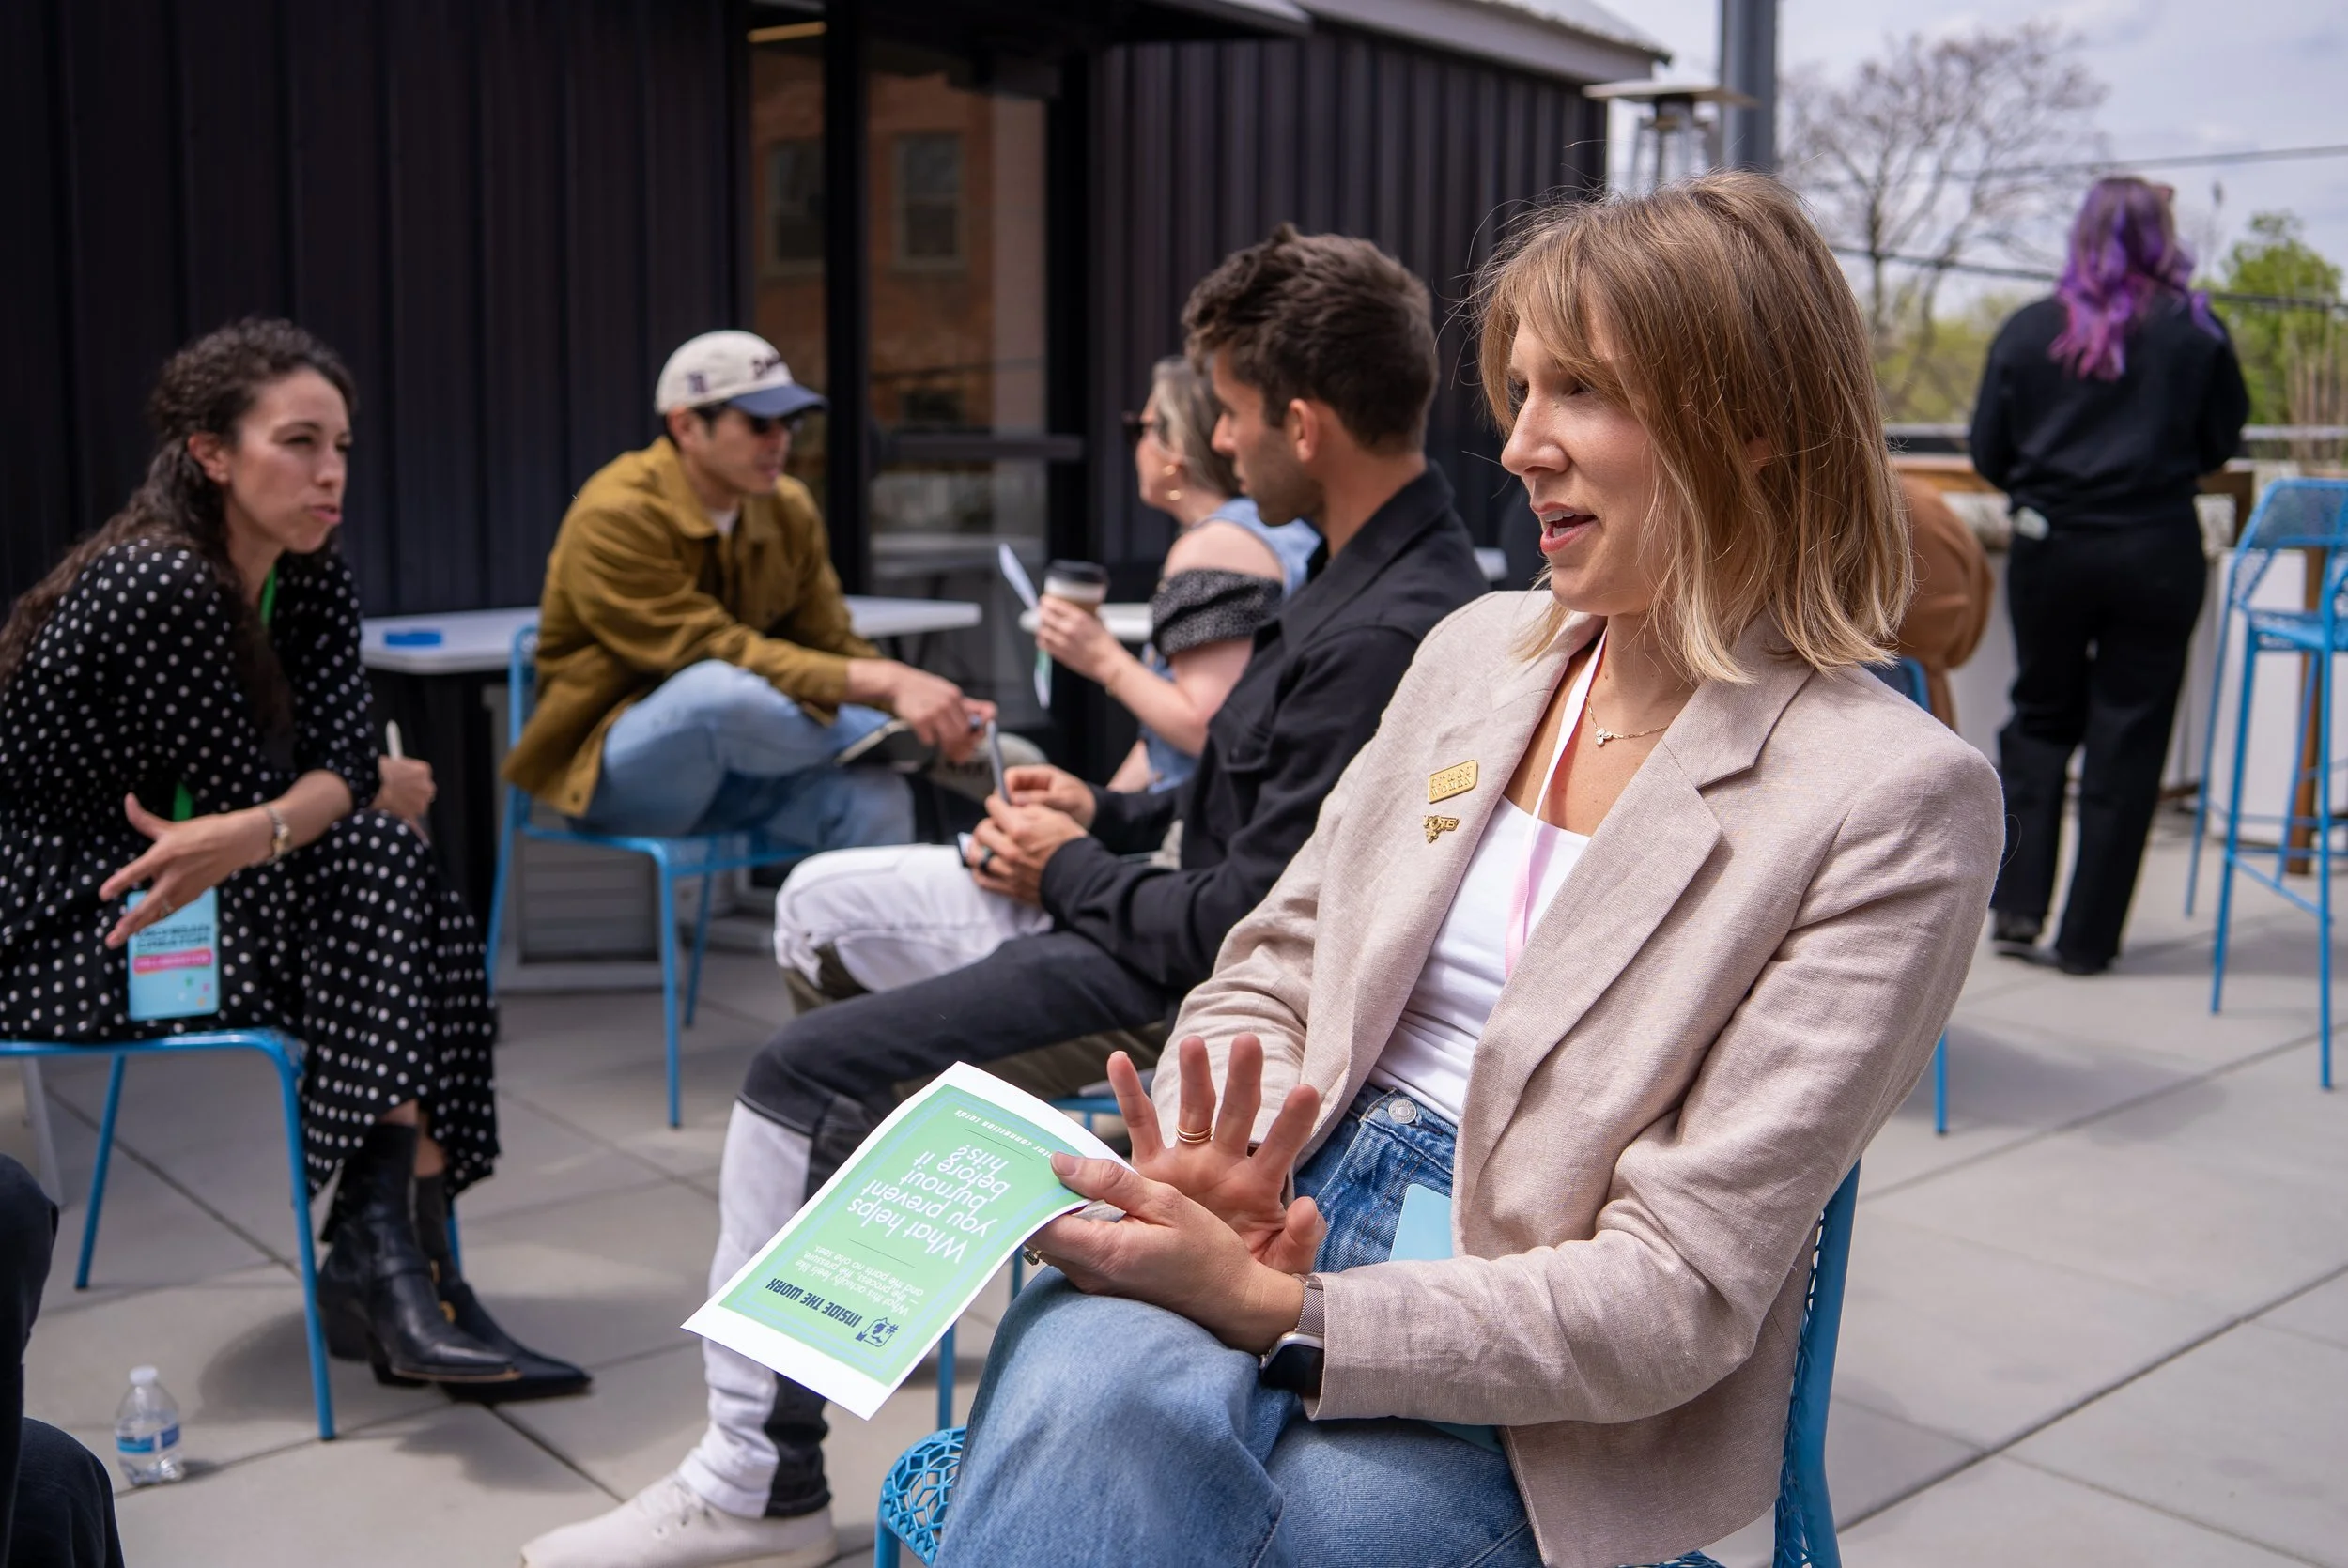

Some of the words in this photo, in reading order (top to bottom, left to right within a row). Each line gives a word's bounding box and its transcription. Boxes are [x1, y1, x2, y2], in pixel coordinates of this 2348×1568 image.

[954, 1109, 981, 1123] cards
[981, 1120, 1031, 1146] connection
[912, 1151, 935, 1169] it
[950, 1144, 1009, 1176] hits?
[936, 1158, 1011, 1202] before
[860, 1179, 950, 1219] prevent
[900, 1169, 987, 1217] burnout
[846, 1198, 905, 1237] helps
[946, 1211, 998, 1237] you
[902, 1222, 968, 1264] What
[796, 1259, 811, 1273] like
[834, 1253, 851, 1266] one
[852, 1261, 864, 1272] no
[811, 1266, 830, 1283] feels
[839, 1268, 854, 1281] the
[864, 1266, 889, 1282] parts
[888, 1276, 903, 1289] the
[765, 1278, 804, 1300] WORK
[831, 1274, 866, 1295] actually
[903, 1284, 924, 1296] and
[799, 1293, 825, 1311] THE
[866, 1289, 882, 1307] this
[891, 1289, 906, 1302] the
[821, 1302, 862, 1328] INSIDE
[882, 1298, 909, 1316] What
